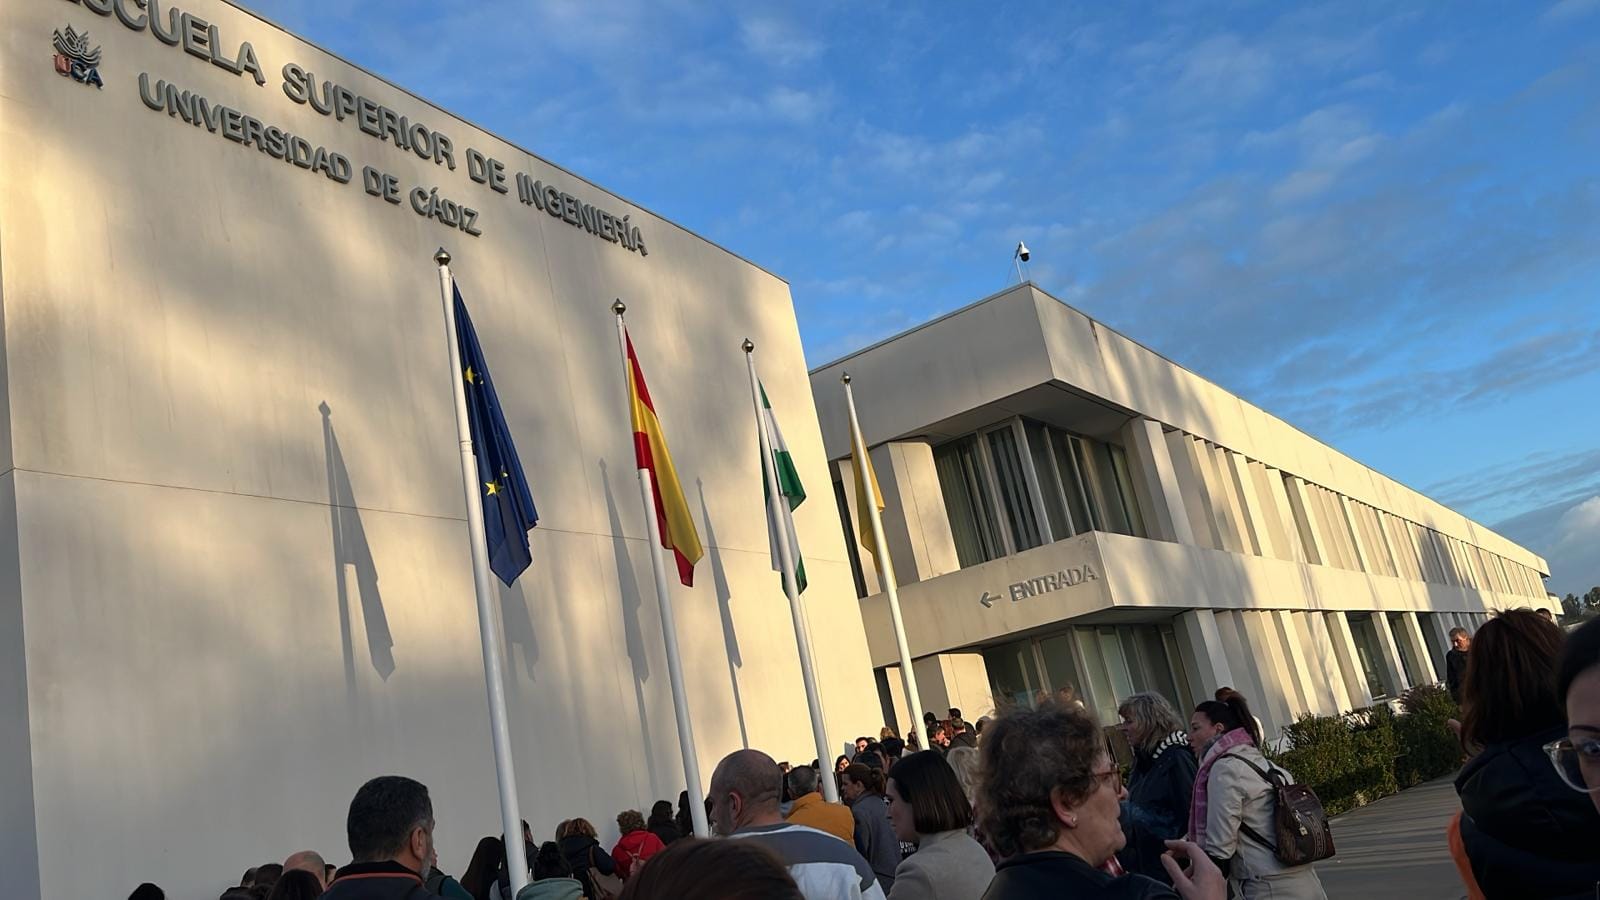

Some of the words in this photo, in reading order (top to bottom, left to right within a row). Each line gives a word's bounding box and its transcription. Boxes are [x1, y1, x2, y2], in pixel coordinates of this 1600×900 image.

[53, 54, 104, 90] UCA
[66, 0, 265, 86] CUELA
[282, 63, 456, 171] SUPERIOR
[466, 147, 508, 194] DE
[516, 172, 648, 256] INGENIERÍA
[138, 72, 352, 184] UNIVERSIDAD
[363, 165, 401, 203] DE
[410, 186, 482, 237] CÁDIZ
[1009, 564, 1098, 601] ENTRADA
